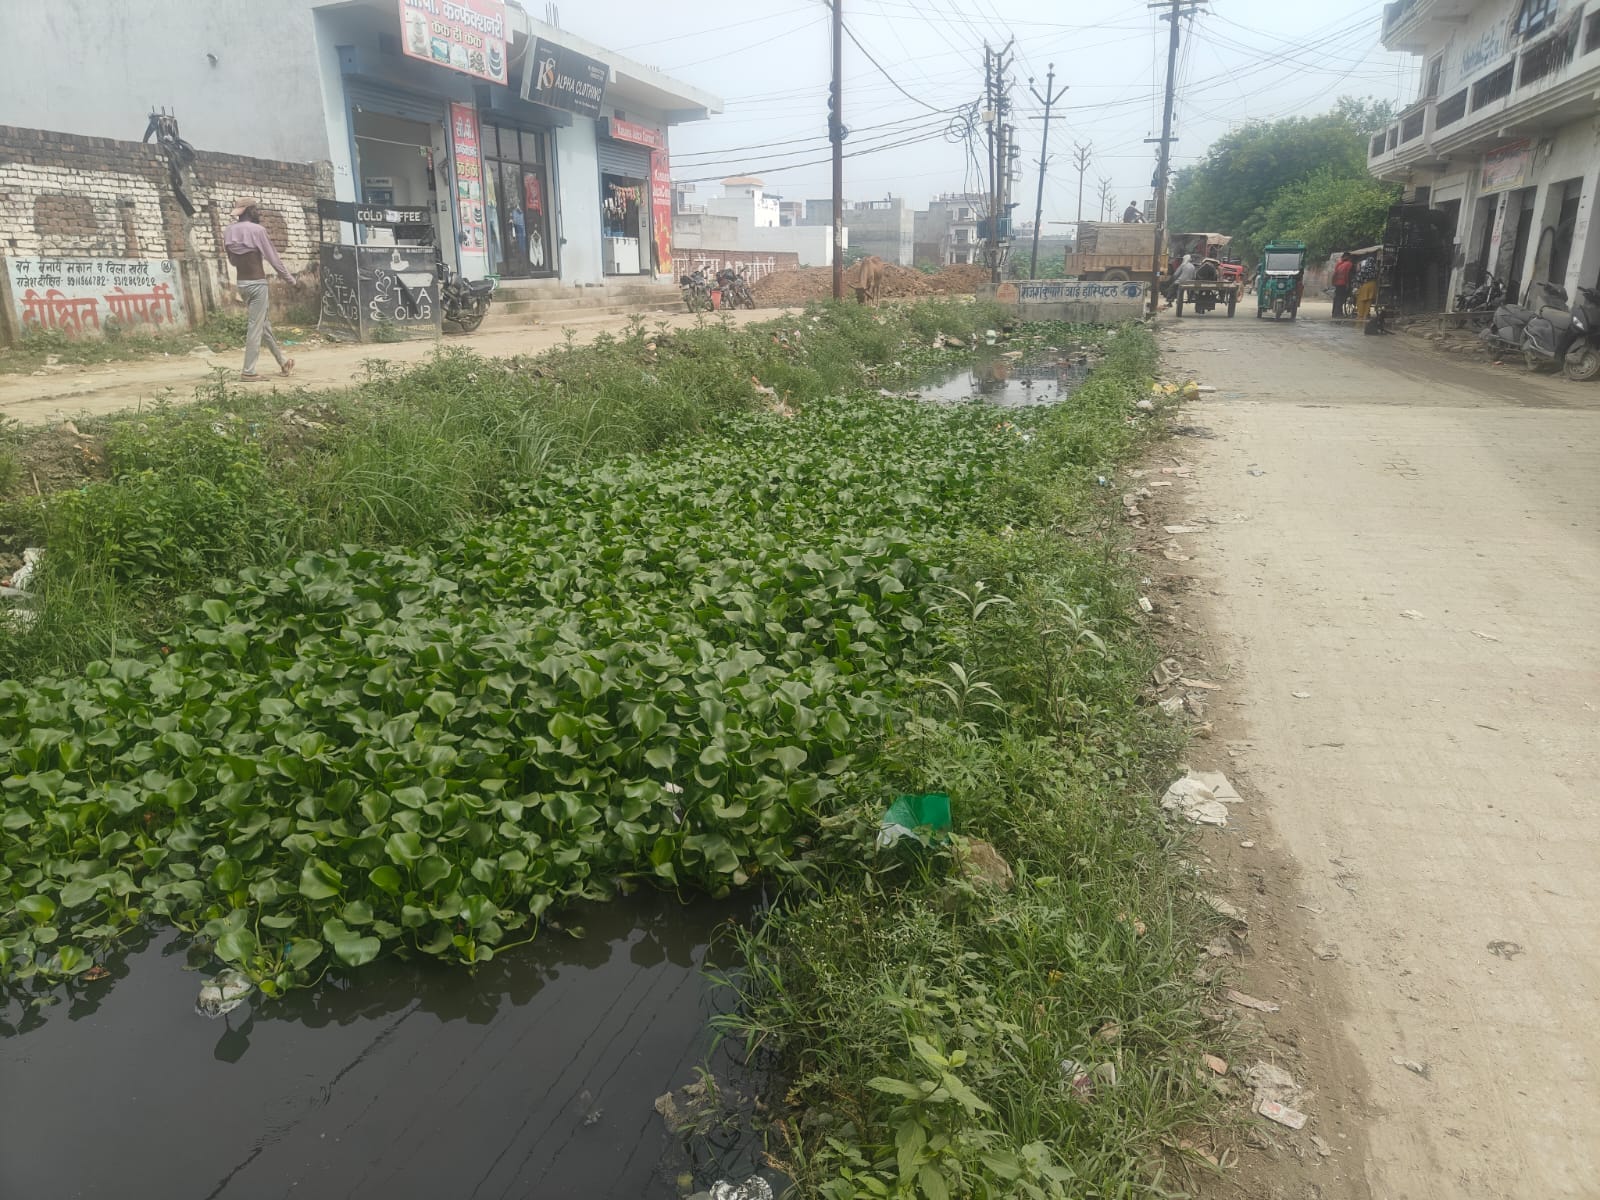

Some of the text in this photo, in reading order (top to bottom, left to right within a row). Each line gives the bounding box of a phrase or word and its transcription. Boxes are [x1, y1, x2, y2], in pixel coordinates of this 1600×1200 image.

[555, 73, 602, 102] ALPHA CLOTHING
[357, 210, 383, 222] COLD
[65, 262, 93, 275] मकान
[105, 261, 126, 276] विला
[393, 287, 432, 305] TA
